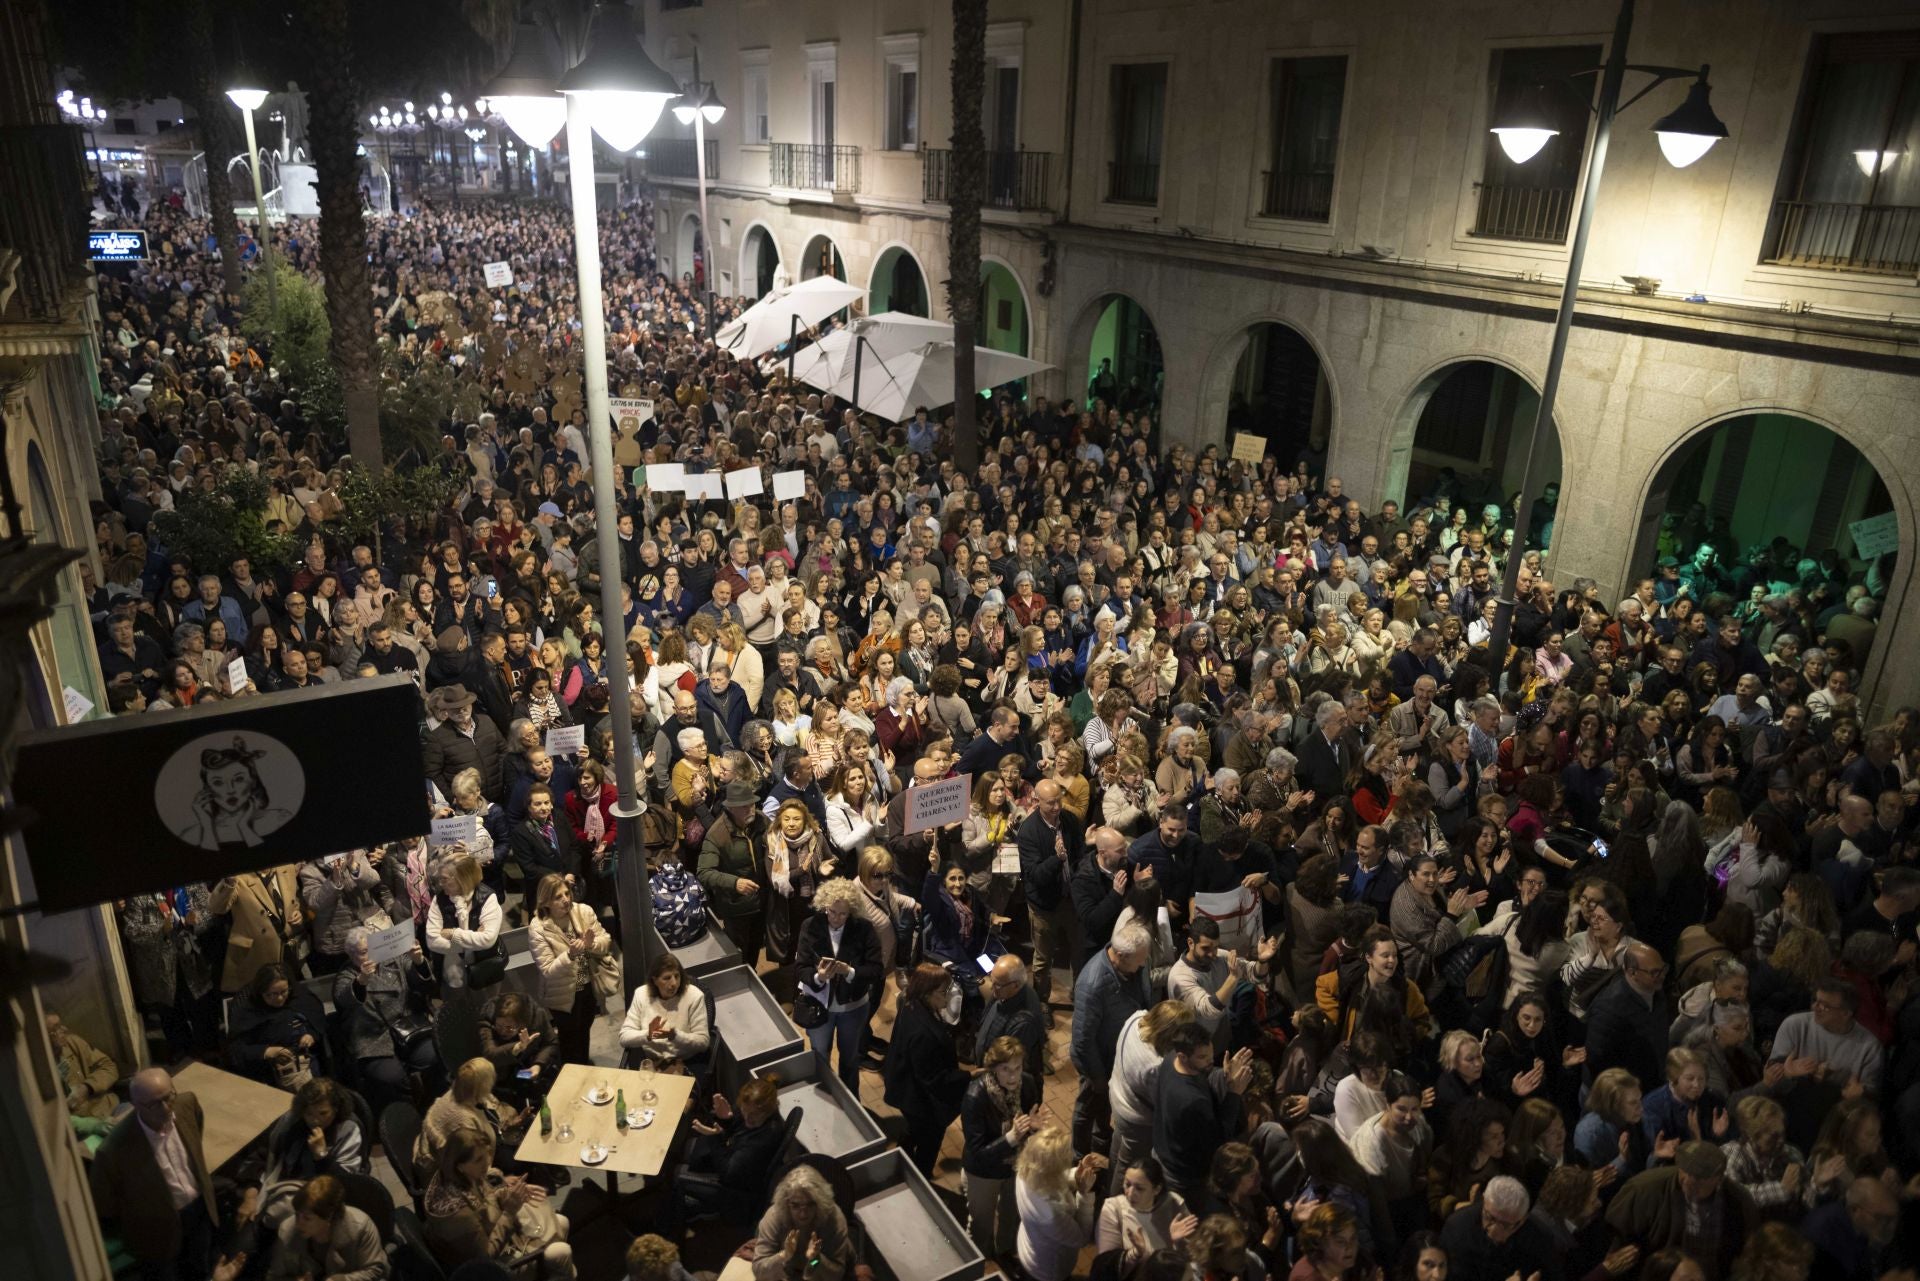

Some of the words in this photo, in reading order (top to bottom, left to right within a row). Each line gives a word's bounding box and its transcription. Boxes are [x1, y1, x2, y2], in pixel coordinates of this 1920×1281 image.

[917, 783, 962, 801] ¡QUEREMOS
[920, 793, 959, 809] NUESTROS
[916, 806, 947, 819] CHARES
[948, 802, 961, 811] YA!
